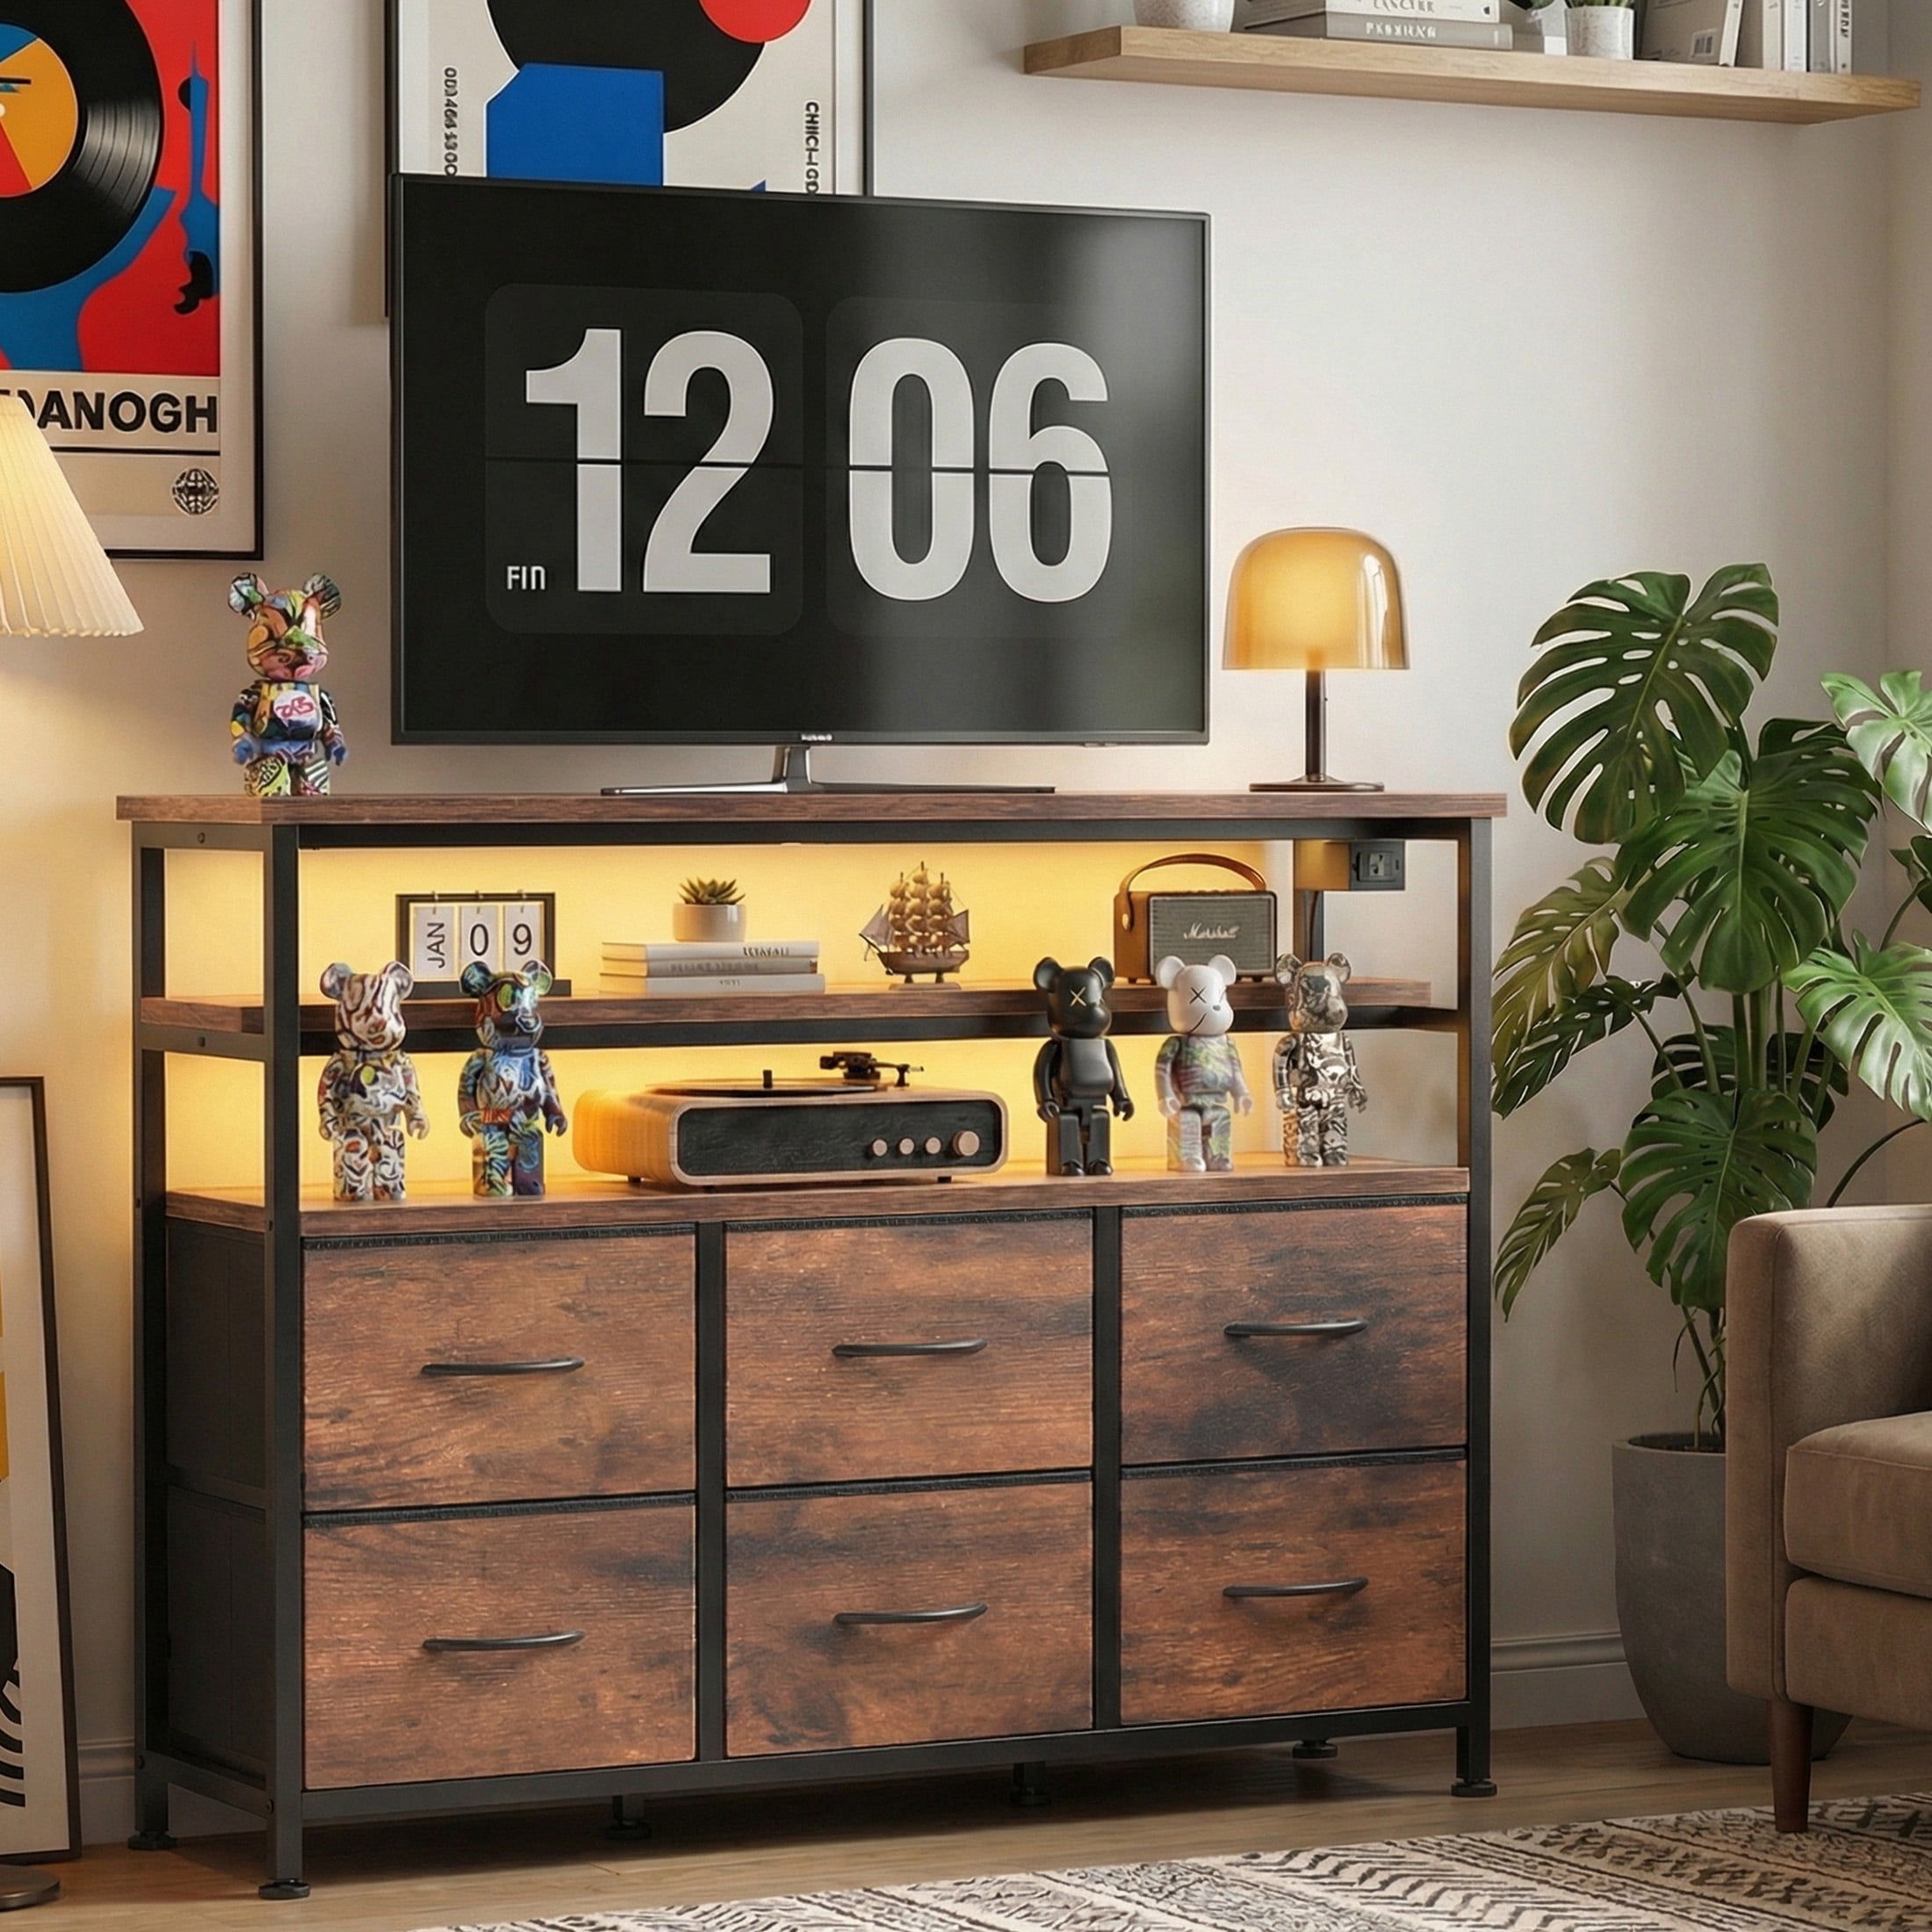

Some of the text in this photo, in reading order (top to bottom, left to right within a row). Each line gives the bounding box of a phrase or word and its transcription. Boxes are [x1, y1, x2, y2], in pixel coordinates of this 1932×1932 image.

[526, 328, 1113, 602] 12 06
[427, 922, 445, 969] JAN
